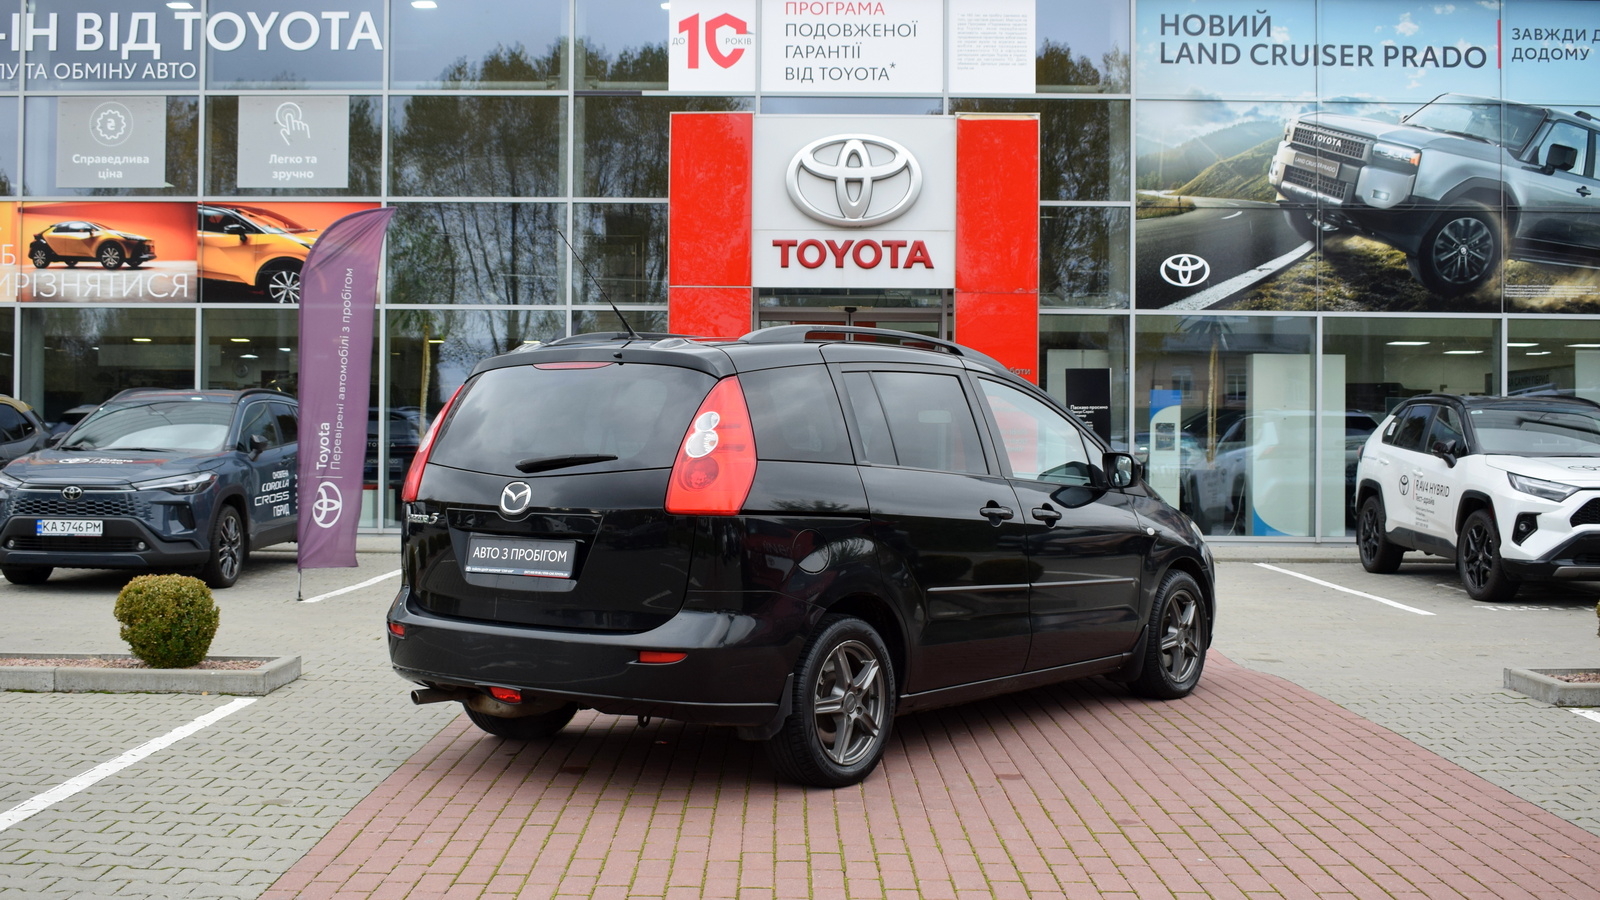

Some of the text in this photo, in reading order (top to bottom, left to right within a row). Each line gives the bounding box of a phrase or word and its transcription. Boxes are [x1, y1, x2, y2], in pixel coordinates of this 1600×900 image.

[785, 1, 885, 16] ПРОГРАМА
[785, 20, 919, 38] ПОДОВЖЕНОЇ
[1160, 9, 1272, 38] НОВИЙ
[76, 12, 161, 60] ВІД
[174, 11, 384, 51] TOYOTA
[672, 38, 685, 46] ДО
[725, 37, 752, 45] РОКІВ
[1511, 27, 1587, 44] ЗАВЖДИ
[785, 42, 862, 59] ГАРАНТІЇ
[1160, 42, 1487, 69] LAND CRUISER PRADO
[1511, 47, 1590, 63] ДОДОМУ
[25, 63, 48, 80] ТА
[53, 62, 138, 80] ОБМІНУ
[142, 62, 197, 80] АВТО
[785, 67, 814, 83] ВІД
[72, 153, 150, 165] Справедлива
[268, 154, 318, 164] Легко та
[98, 168, 123, 180] ціна
[272, 170, 315, 181] зручно
[772, 238, 934, 269] TOYOTA
[341, 268, 354, 323] пробігом
[338, 335, 349, 400] автомобілі
[330, 403, 344, 470] Перевірені
[316, 422, 331, 470] Toyota
[262, 479, 290, 492] COROLLA
[1415, 479, 1450, 498] RAV4 HYBRID
[254, 491, 290, 506] CROSS
[429, 512, 440, 525] 5
[43, 521, 102, 533] KA 3746 PM
[472, 546, 500, 559] АВТО
[510, 548, 568, 562] ПРОБІГОМ
